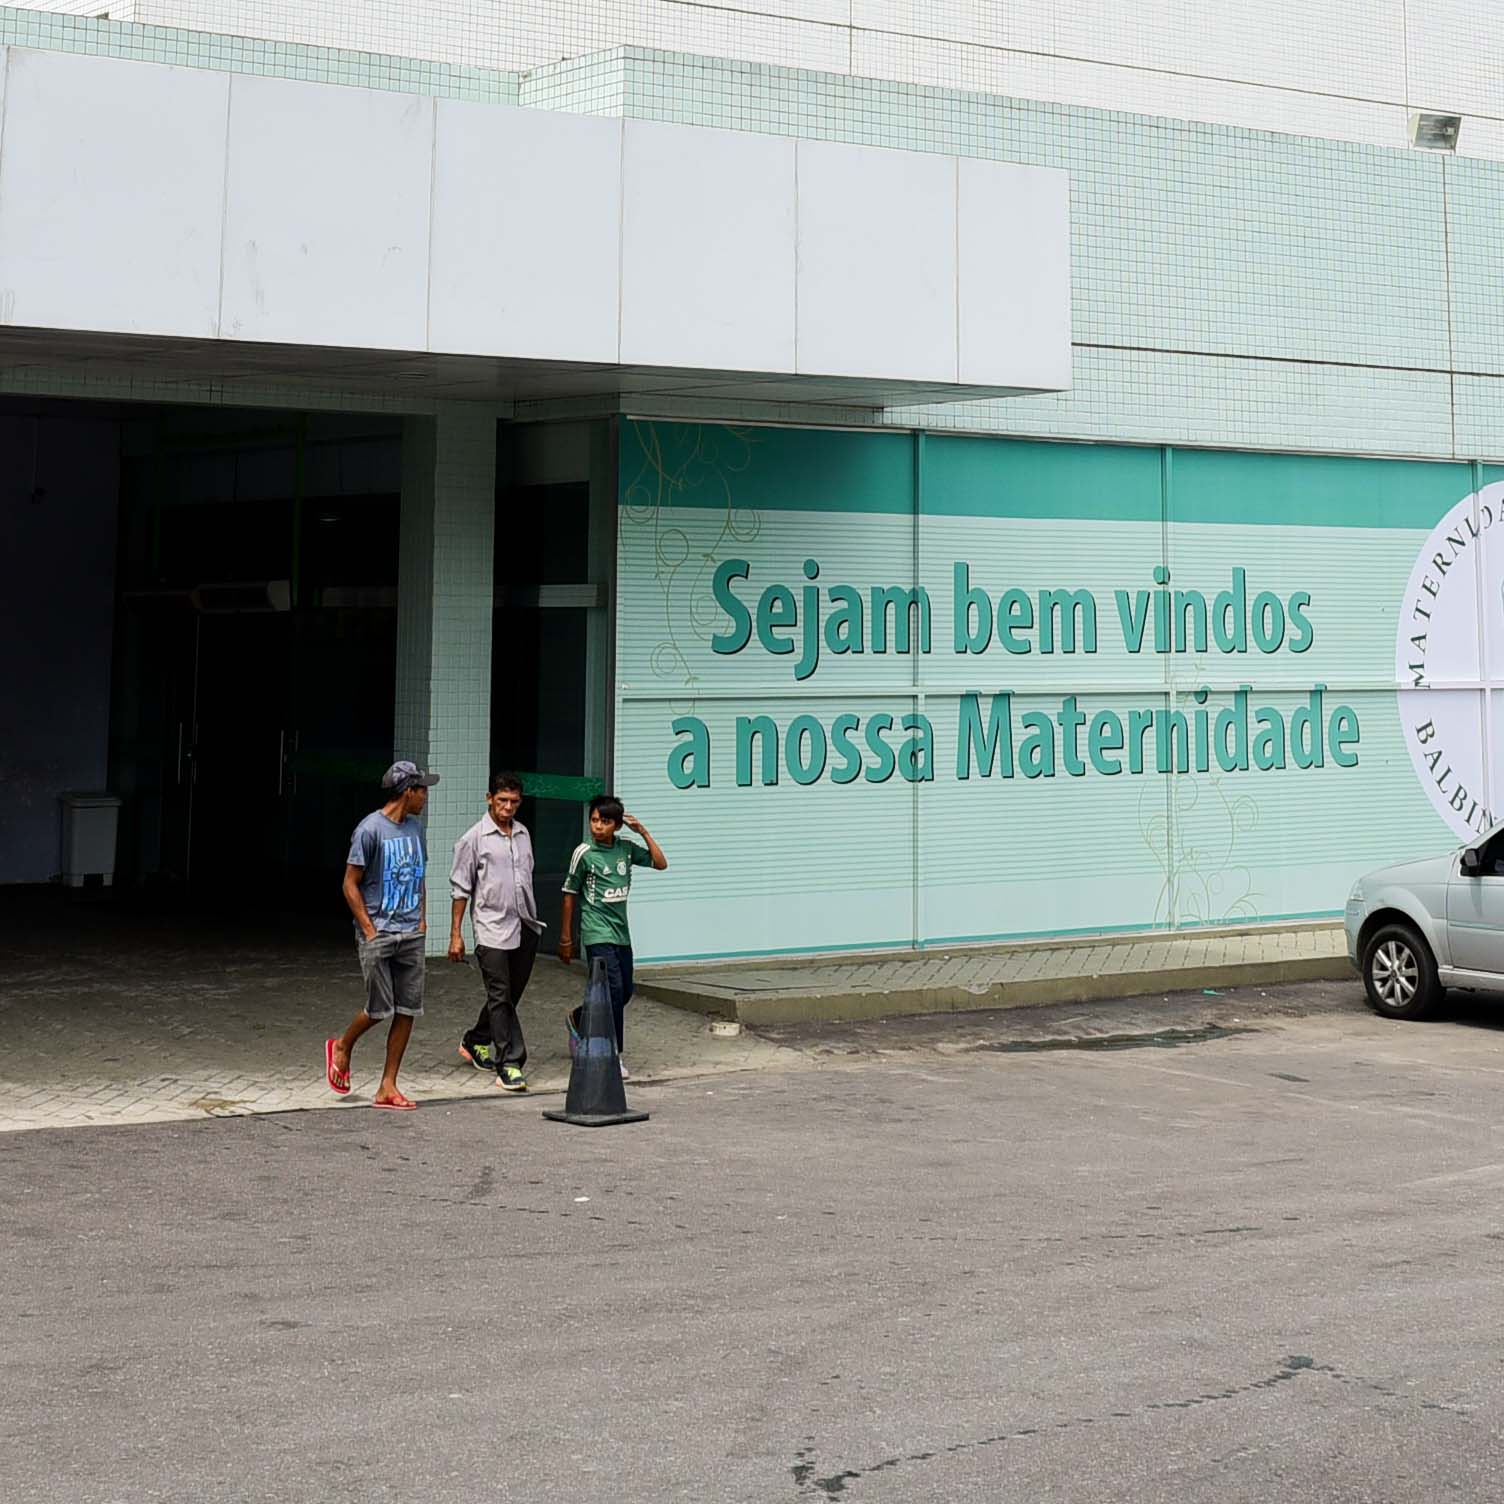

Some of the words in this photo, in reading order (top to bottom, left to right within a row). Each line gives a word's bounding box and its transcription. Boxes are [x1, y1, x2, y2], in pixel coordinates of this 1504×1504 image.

[711, 558, 930, 680] Sejam
[954, 560, 1096, 657] bem
[1114, 565, 1315, 657] vindos
[667, 719, 711, 790] a
[735, 710, 934, 789] nossa
[957, 684, 1360, 783] Maternidade
[1415, 718, 1496, 835] BALBIN
